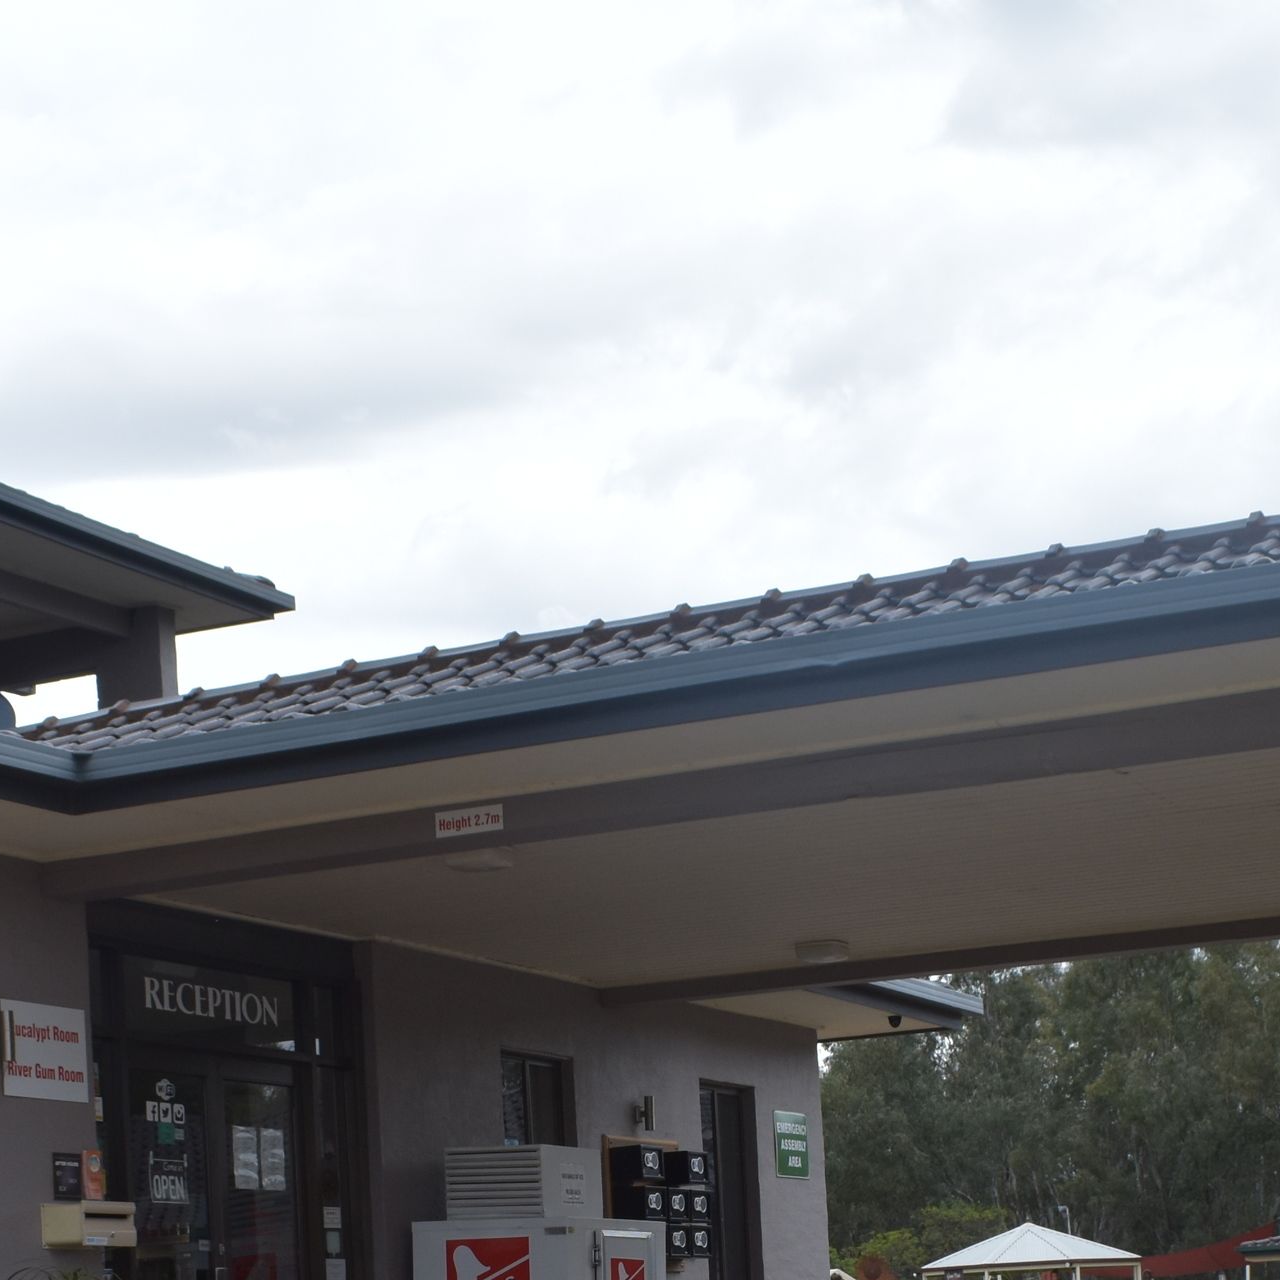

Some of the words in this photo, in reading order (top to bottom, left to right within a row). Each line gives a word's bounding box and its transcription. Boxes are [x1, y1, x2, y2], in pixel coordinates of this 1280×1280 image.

[438, 816, 472, 832] Height
[474, 812, 500, 827] 2.7m
[144, 976, 278, 1026] RECEPTION
[14, 1024, 51, 1043] ucalypt
[53, 1026, 79, 1044] Room
[7, 1060, 32, 1078] River
[35, 1063, 55, 1080] Gum
[58, 1066, 84, 1083] Room
[788, 1155, 802, 1168] AREA
[153, 1174, 185, 1200] OPEN
